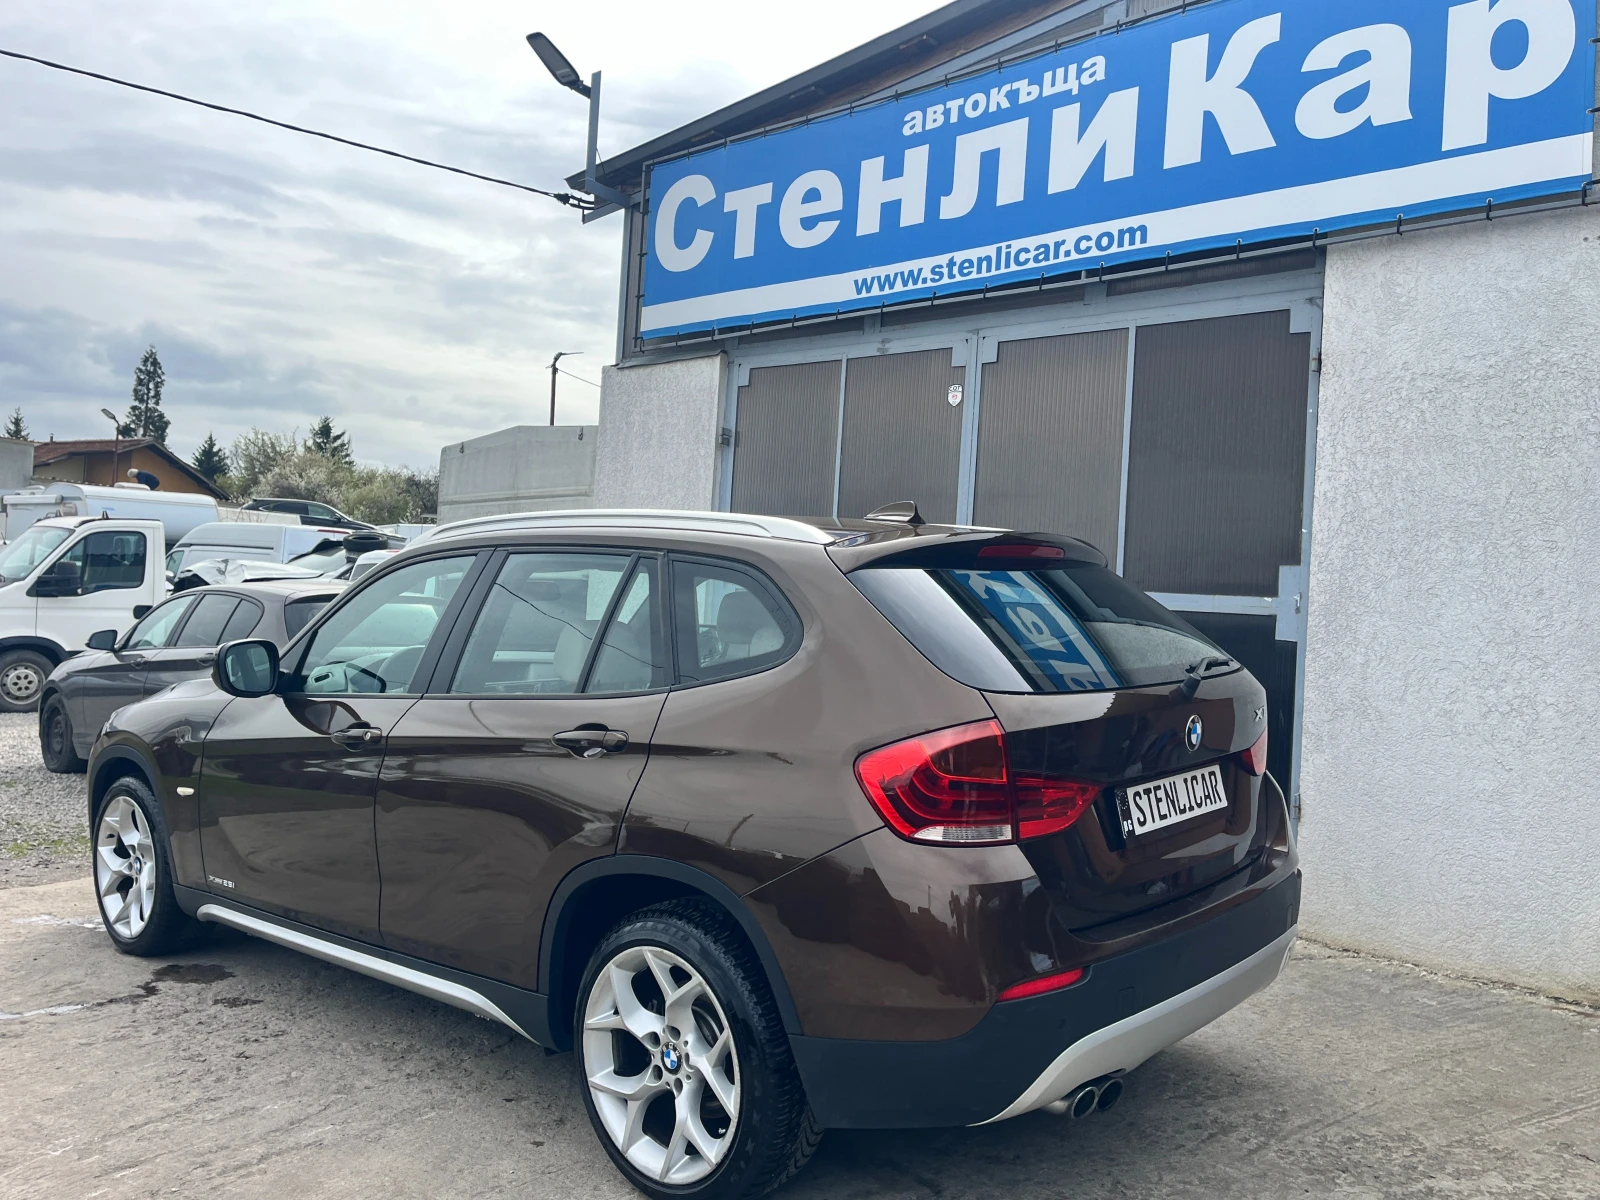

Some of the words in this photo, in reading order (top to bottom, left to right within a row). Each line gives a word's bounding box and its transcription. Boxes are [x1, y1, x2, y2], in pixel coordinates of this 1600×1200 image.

[902, 55, 1106, 136] автокъща
[853, 222, 1148, 296] www.stenlicar.com
[1132, 770, 1222, 828] STENLICAR
